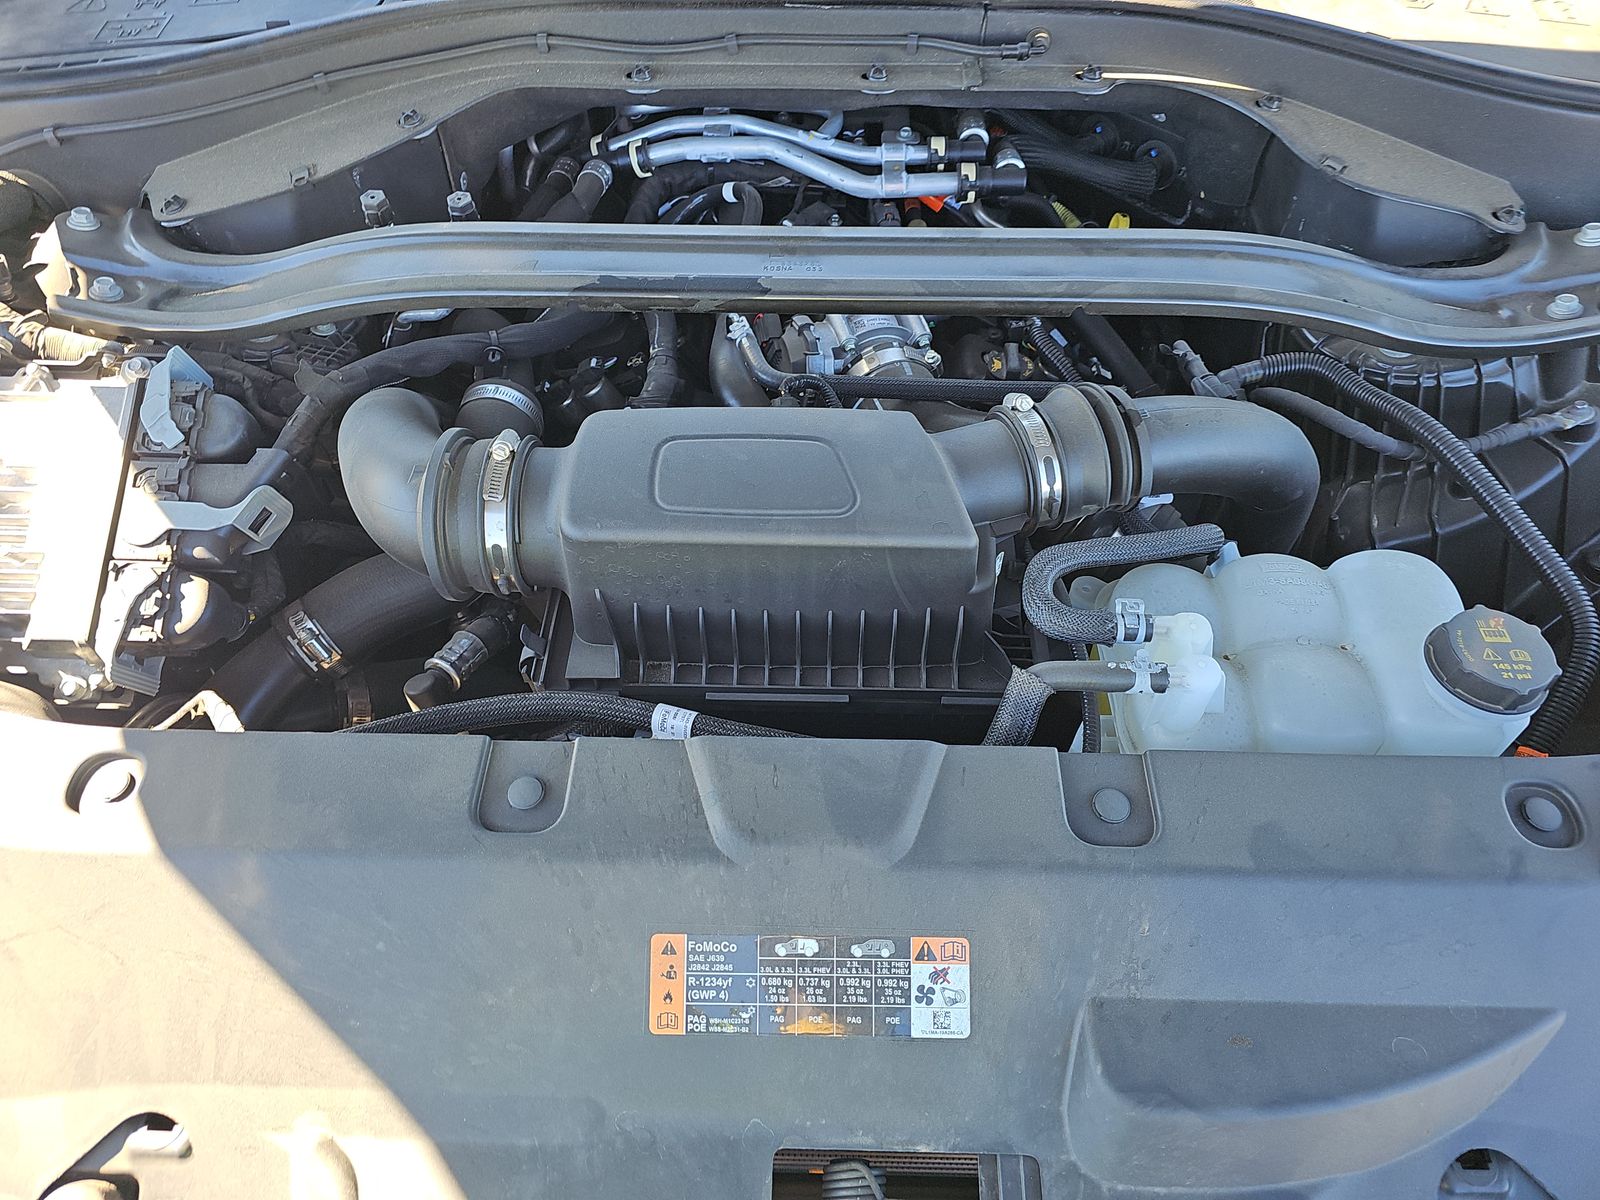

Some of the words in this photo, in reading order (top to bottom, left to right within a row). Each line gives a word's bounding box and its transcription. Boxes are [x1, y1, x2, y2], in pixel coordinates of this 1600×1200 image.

[688, 941, 737, 952] FoMoCo
[688, 977, 733, 988] R-1234yf
[761, 977, 781, 986] 0.680
[783, 978, 793, 988] kg
[799, 978, 818, 986] 0.737
[821, 978, 830, 988] kg
[839, 978, 860, 986] 0.992
[861, 978, 870, 988] kg
[877, 979, 897, 987] 0.992
[900, 979, 909, 989] kg
[688, 990, 716, 1001] (GWP
[719, 990, 729, 1001] 4)
[688, 1015, 707, 1023] PAG
[688, 1024, 707, 1032] POE
